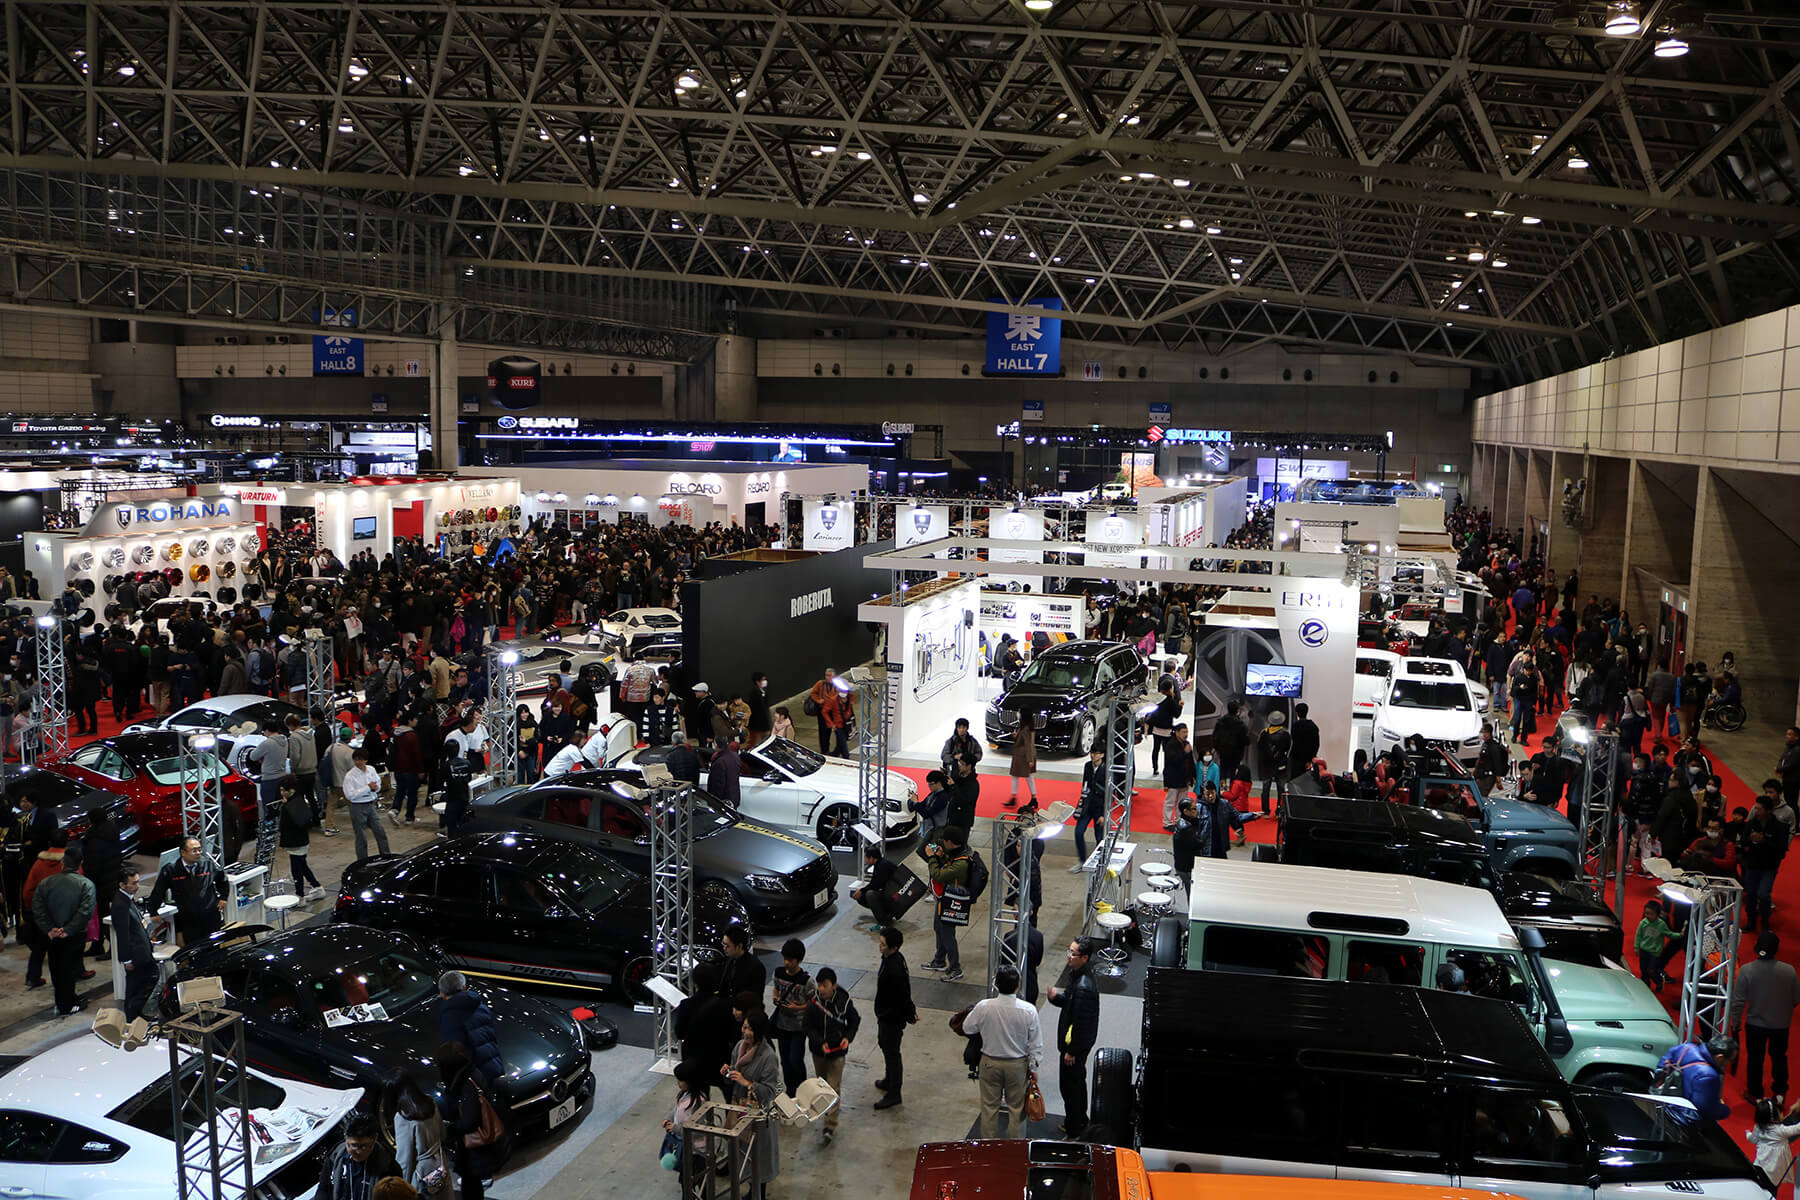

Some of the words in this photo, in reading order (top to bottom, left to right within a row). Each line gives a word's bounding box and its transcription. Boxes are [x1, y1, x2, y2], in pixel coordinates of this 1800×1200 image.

[1004, 304, 1043, 341] 東
[1011, 343, 1035, 351] EAST
[320, 360, 346, 370] HALL
[346, 355, 356, 370] 8
[997, 358, 1034, 370] HALL
[1034, 353, 1048, 370] 7
[519, 417, 579, 428] SUBARU
[891, 423, 914, 434] SUBARU
[1165, 429, 1232, 442] SUZUKI
[1278, 463, 1326, 473] SWIFT
[671, 482, 722, 493] RECARO
[748, 482, 770, 493] RECARO
[136, 503, 230, 523] ROHANA
[1094, 544, 1108, 552] NEW
